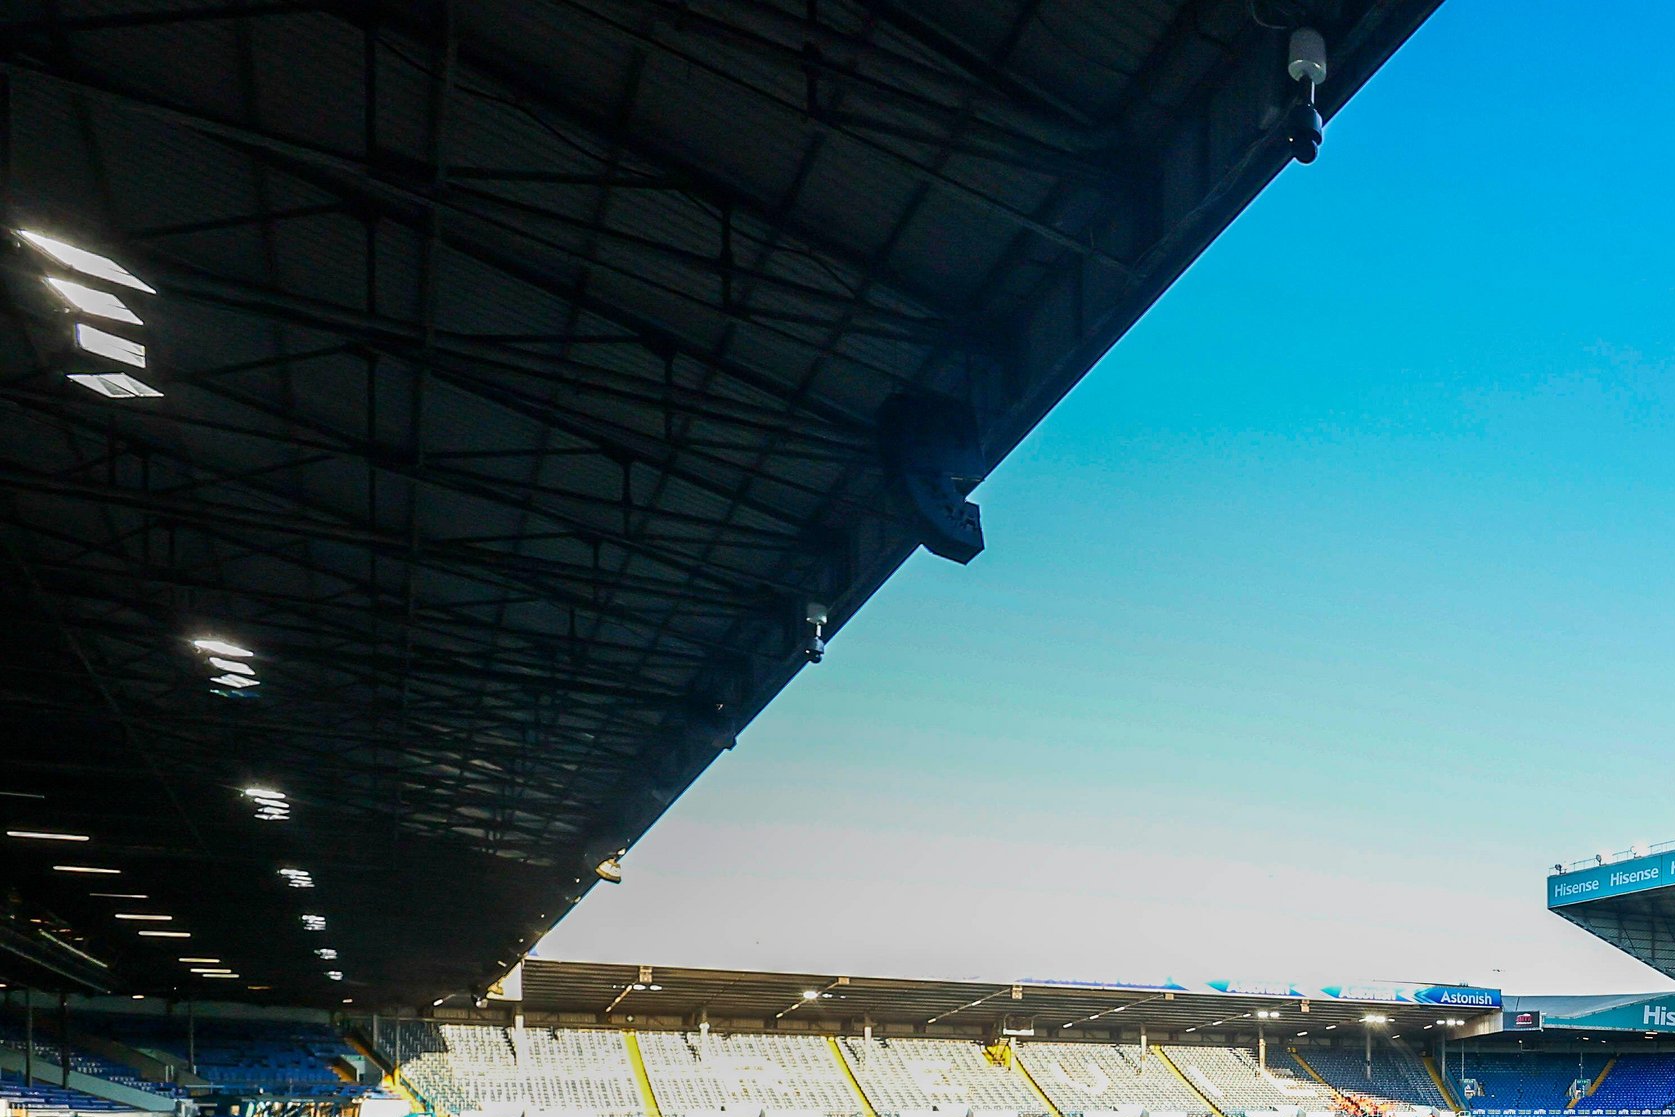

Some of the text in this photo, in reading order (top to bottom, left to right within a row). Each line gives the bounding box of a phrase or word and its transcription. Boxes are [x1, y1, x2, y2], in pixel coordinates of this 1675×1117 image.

[1609, 865, 1659, 887] Hisense
[1554, 877, 1599, 898] Hisense
[1440, 990, 1492, 1006] Astonish
